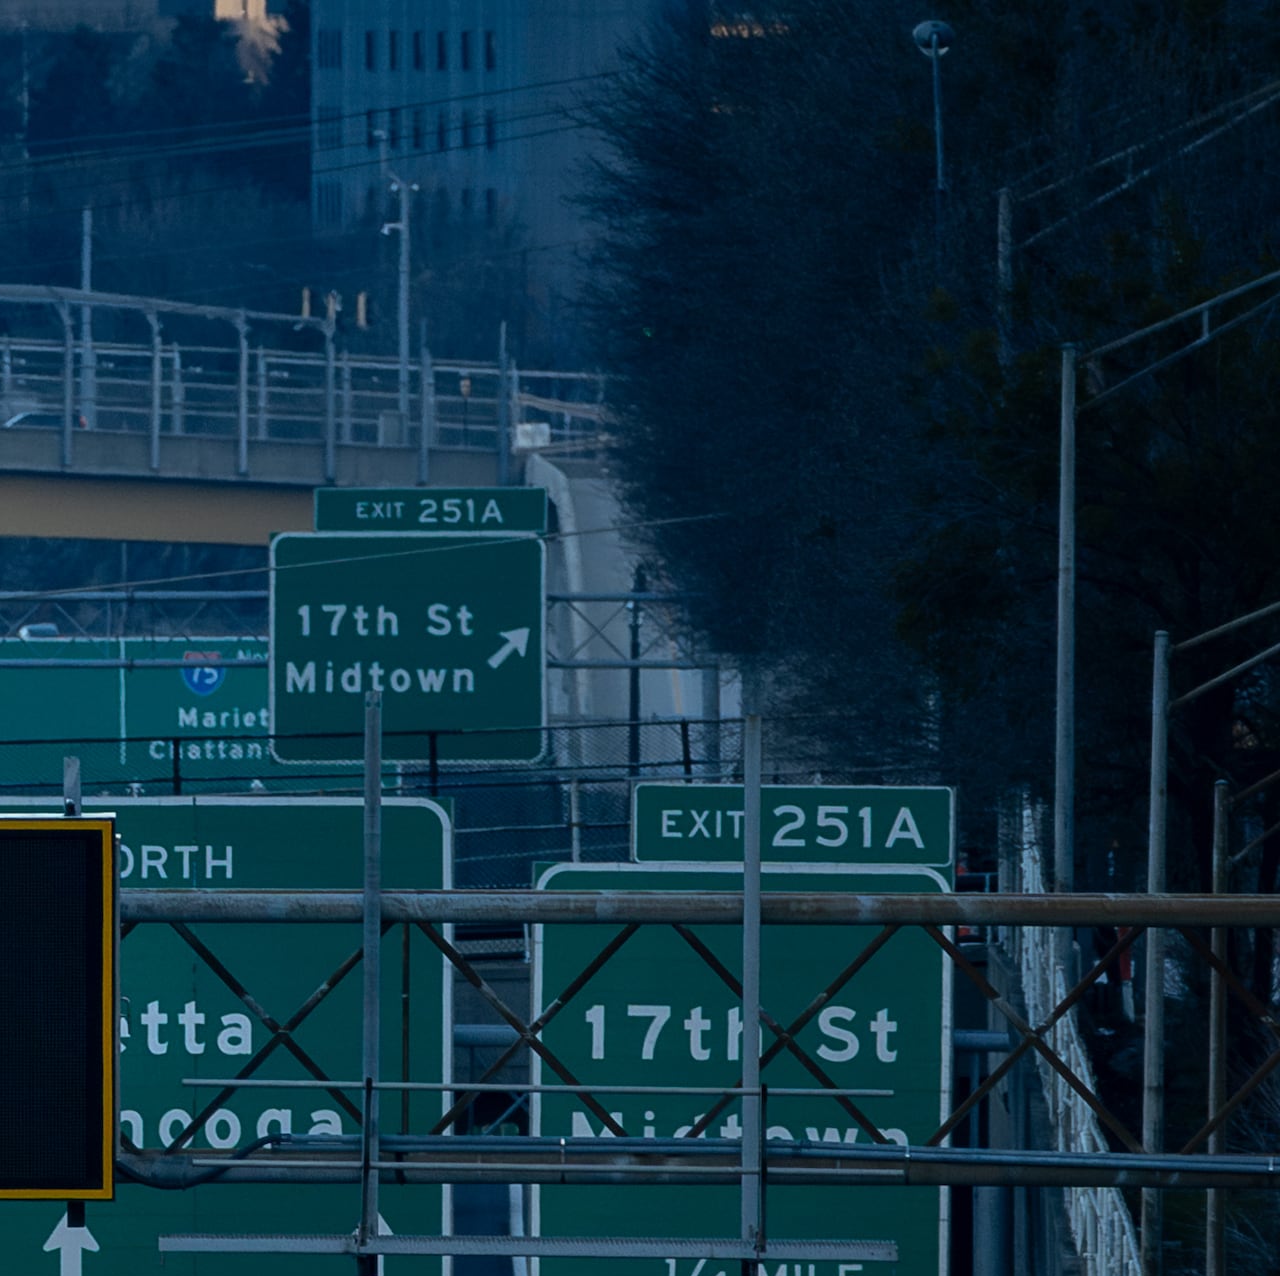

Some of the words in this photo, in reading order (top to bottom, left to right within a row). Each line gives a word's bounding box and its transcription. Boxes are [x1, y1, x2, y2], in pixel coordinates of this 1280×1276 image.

[356, 501, 405, 519] EXIT
[419, 498, 504, 523] 251A
[297, 603, 399, 637] 17th
[426, 602, 474, 637] St
[285, 660, 475, 694] Midtown
[149, 740, 270, 760] Chattan
[660, 808, 745, 840] EXIT
[772, 805, 924, 848] 251A
[584, 1004, 764, 1061] 17th
[817, 1006, 897, 1062] St
